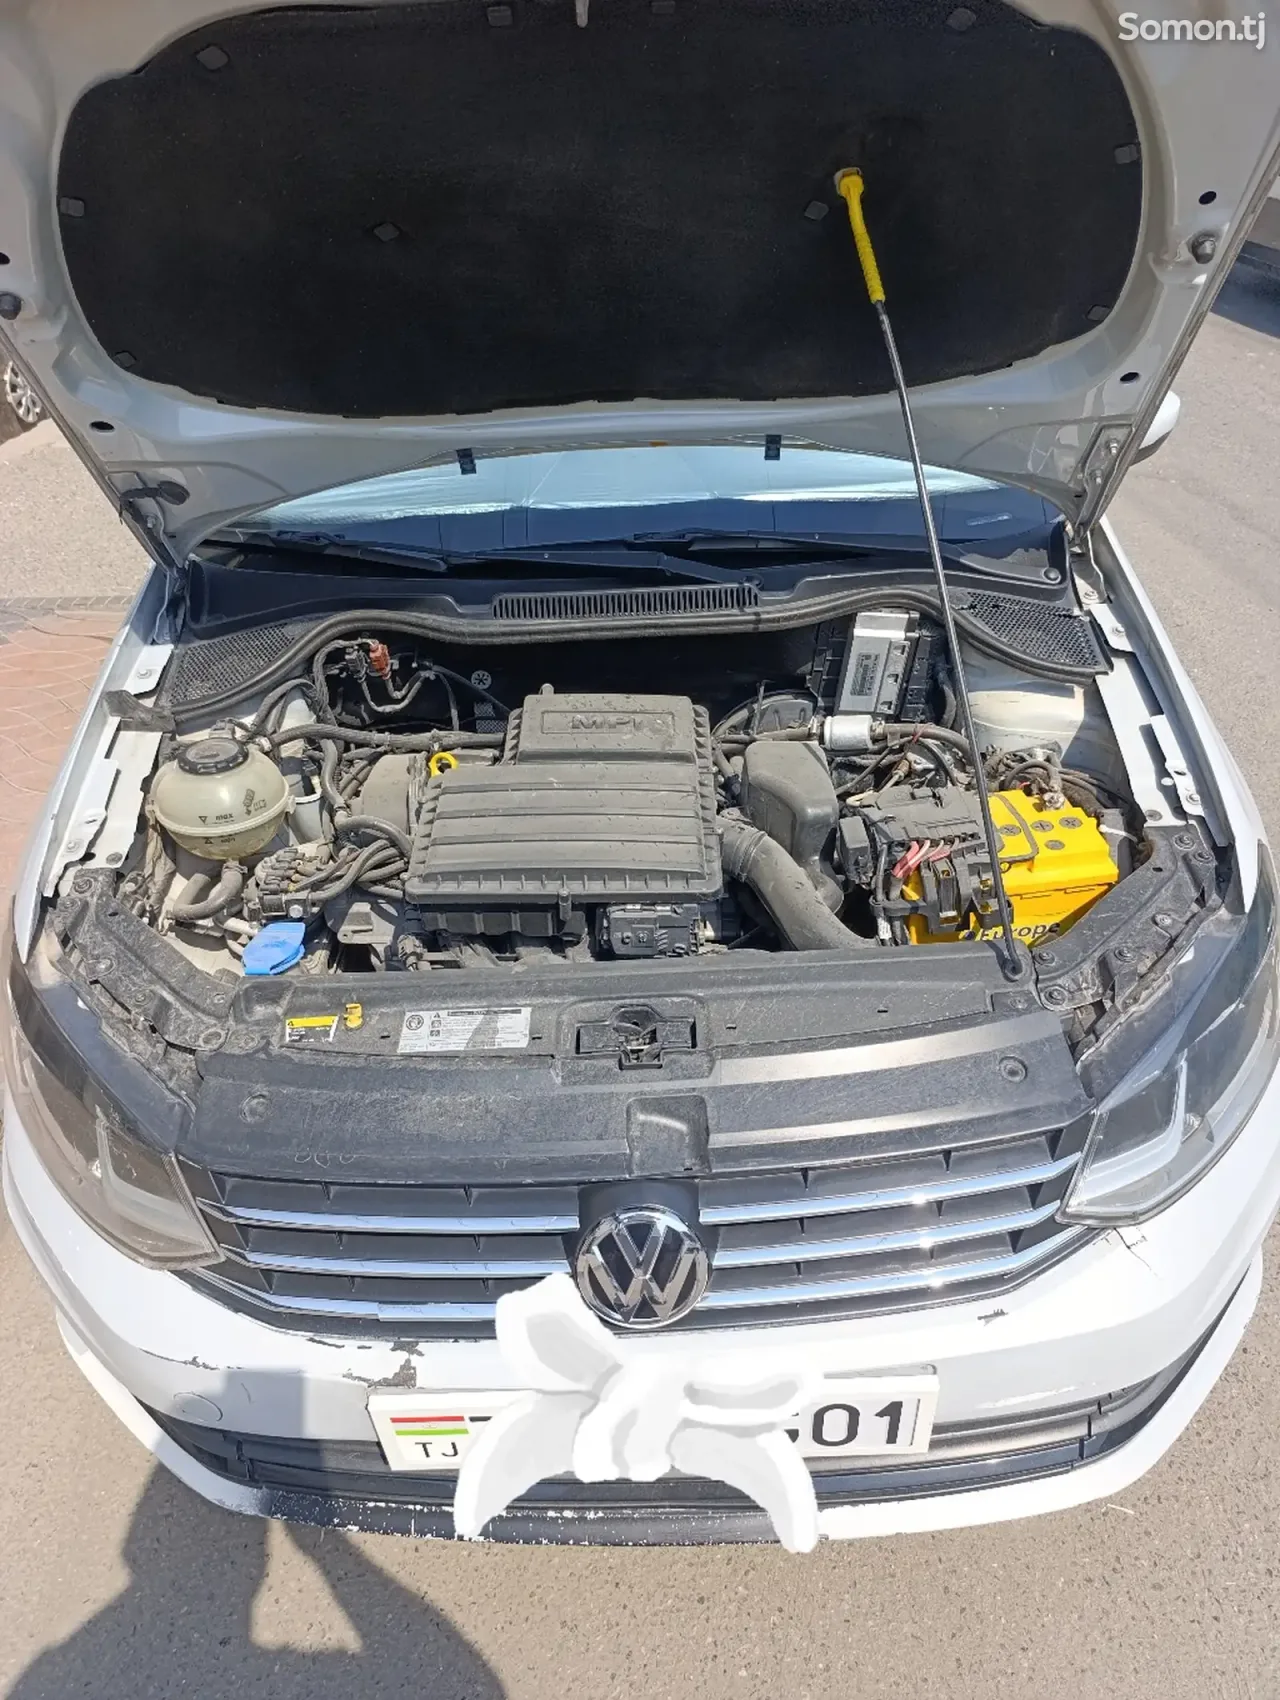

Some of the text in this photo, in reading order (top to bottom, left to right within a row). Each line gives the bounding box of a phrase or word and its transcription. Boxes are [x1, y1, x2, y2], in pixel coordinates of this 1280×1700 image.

[583, 1214, 702, 1325] VW
[784, 1400, 903, 1446] 01
[415, 1442, 459, 1458] TJ
